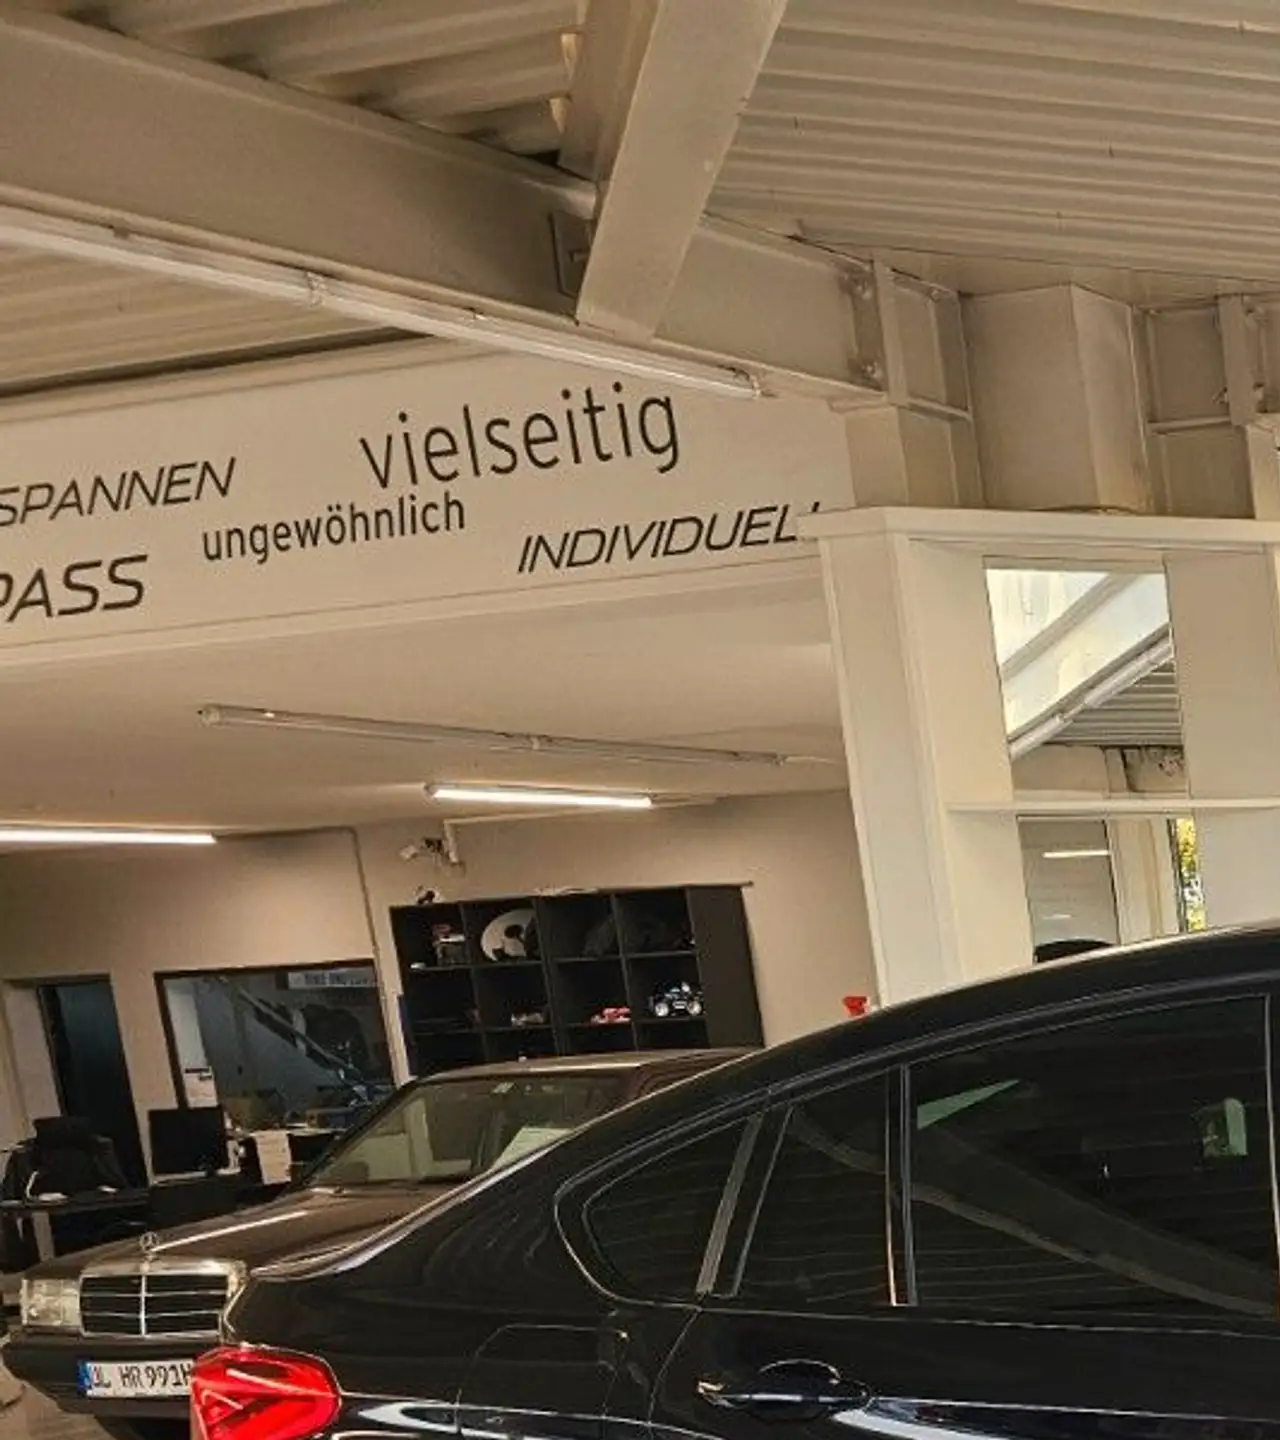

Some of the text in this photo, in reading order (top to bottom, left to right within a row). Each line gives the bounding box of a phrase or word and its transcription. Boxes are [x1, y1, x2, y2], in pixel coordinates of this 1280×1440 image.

[359, 381, 680, 490] vielseitig
[203, 490, 467, 566] ungewöhnlich
[517, 500, 821, 574] INDIVIDUEL
